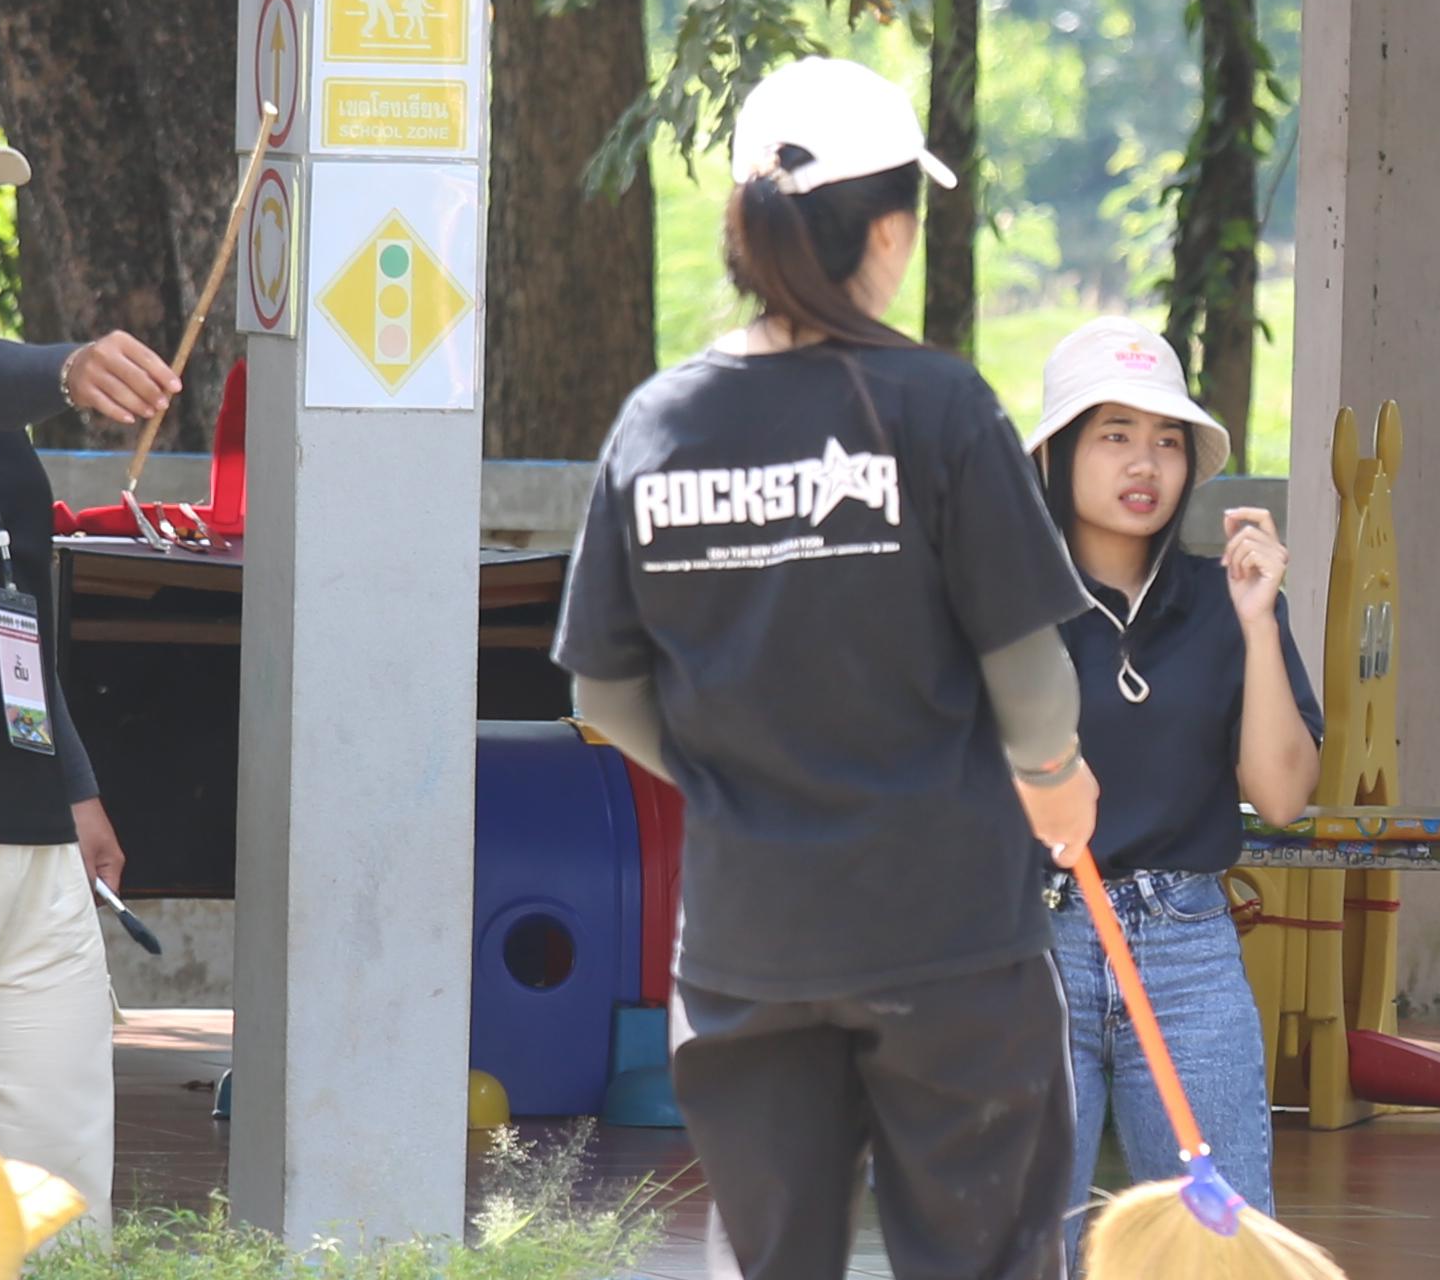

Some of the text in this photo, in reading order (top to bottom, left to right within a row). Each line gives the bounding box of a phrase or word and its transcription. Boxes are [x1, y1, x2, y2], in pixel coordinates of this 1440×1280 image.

[338, 90, 449, 119] เขตโรงเรียน
[339, 124, 449, 140] SCHOOL ZONE
